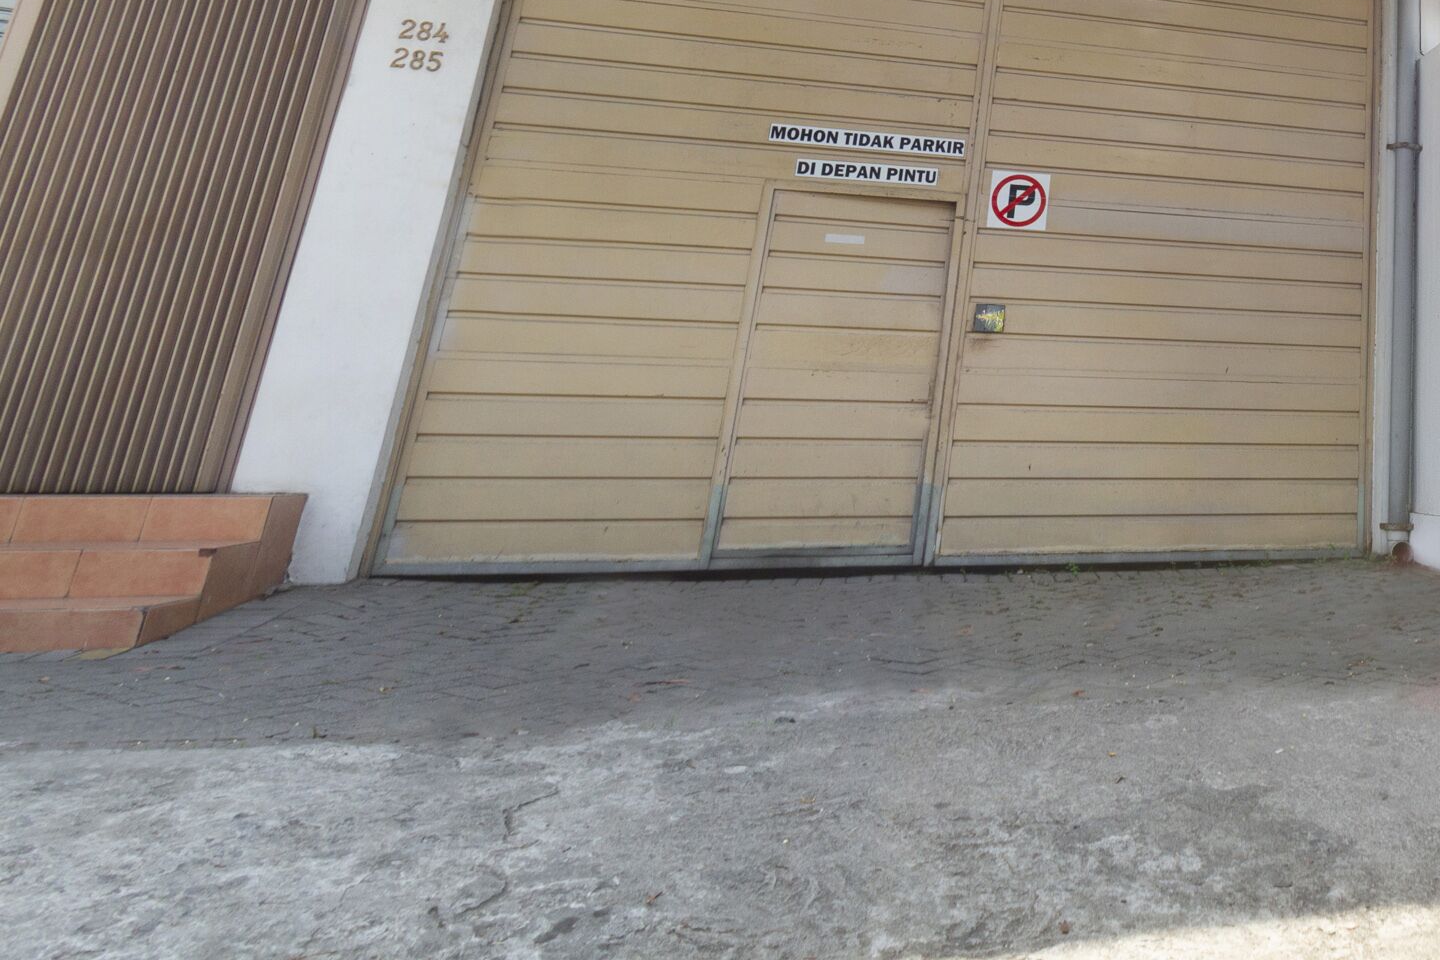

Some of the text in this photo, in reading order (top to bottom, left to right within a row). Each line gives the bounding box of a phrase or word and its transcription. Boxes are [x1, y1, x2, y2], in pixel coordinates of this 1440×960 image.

[398, 19, 449, 43] 284
[390, 47, 444, 72] 285
[770, 126, 964, 155] MOHON TIDAK PARKIR
[797, 161, 937, 183] DI DEPAN PINTU
